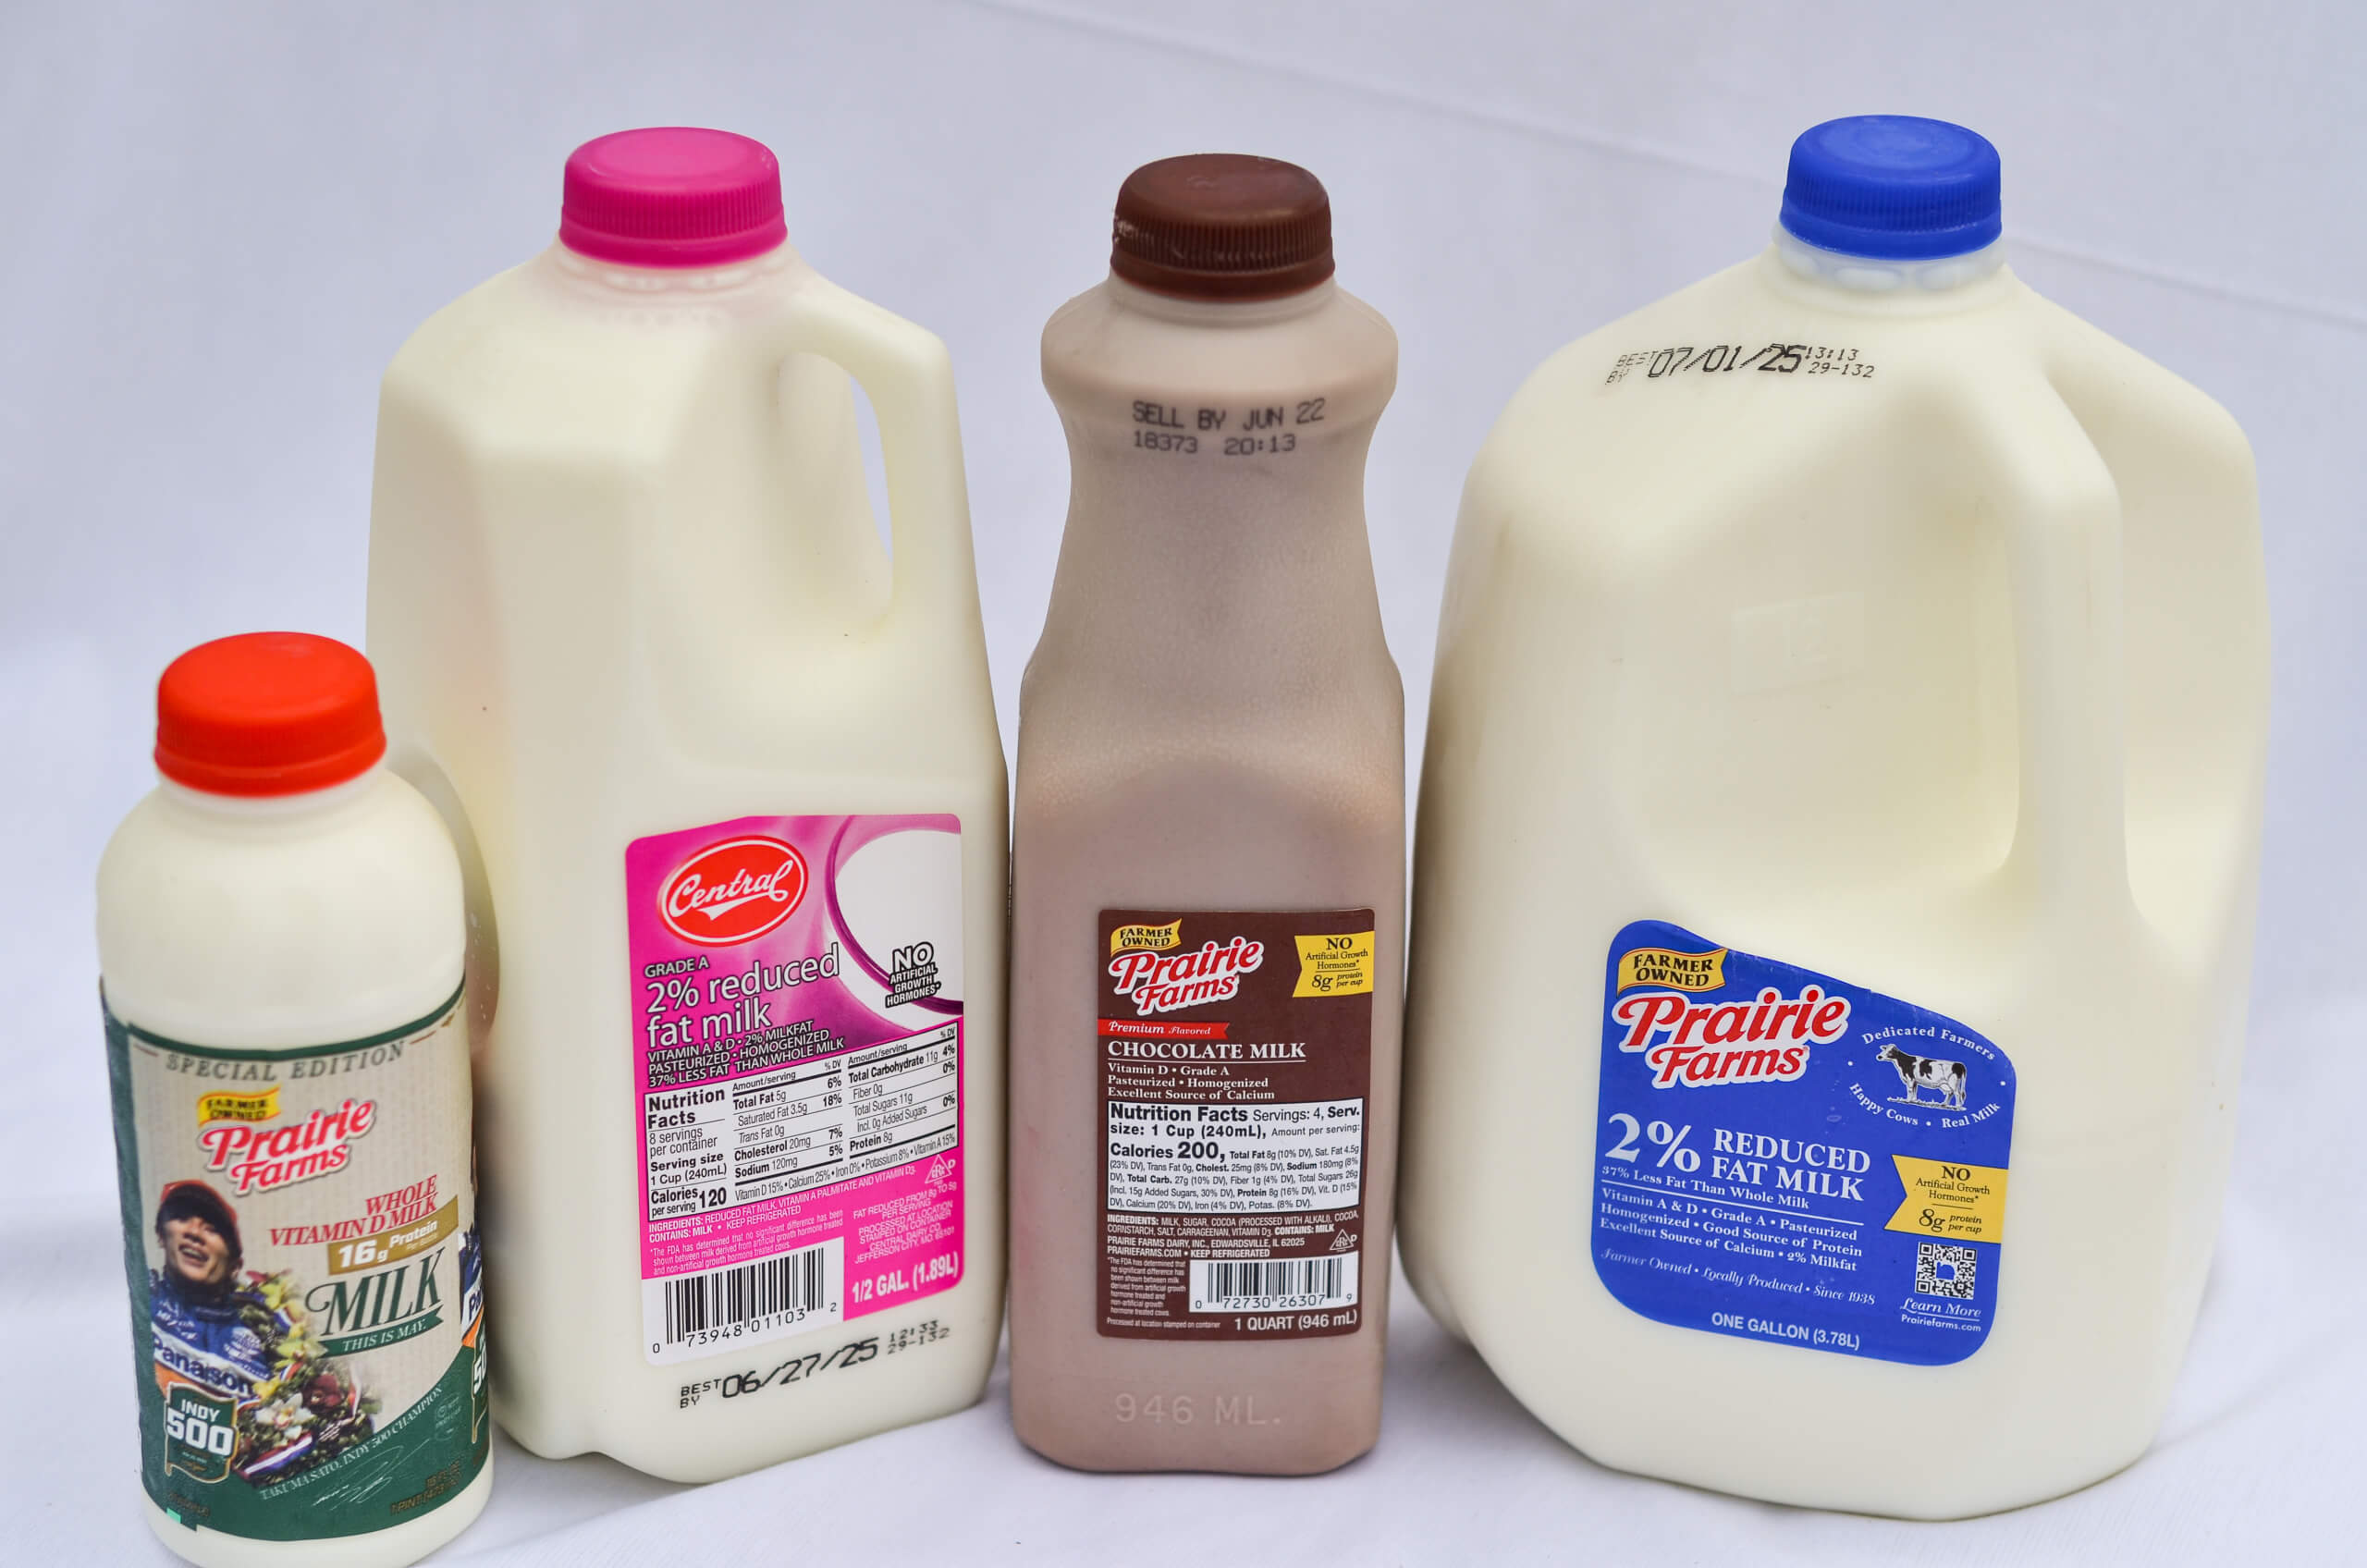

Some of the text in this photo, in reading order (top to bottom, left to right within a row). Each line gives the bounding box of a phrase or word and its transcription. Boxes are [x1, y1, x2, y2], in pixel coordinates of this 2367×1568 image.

[1648, 342, 1808, 379] 07/01/25
[1808, 361, 1875, 379] 29-132
[1132, 397, 1326, 432] SELL BY JUN 22
[1222, 433, 1296, 456] 20:13
[668, 859, 794, 918] Central
[1120, 926, 1173, 939] FARMER
[1122, 937, 1171, 949] OWNED
[1326, 937, 1354, 951] NO
[644, 956, 710, 978] GRADE A
[892, 941, 935, 974] NO
[1110, 937, 1261, 991] Prairie
[1305, 948, 1368, 962] Artificial Growth
[1633, 953, 1715, 973] FARMER
[647, 941, 840, 1014] 2% reduced
[889, 963, 938, 986] ARTIFICIAL
[894, 975, 934, 995] GROWTH
[1311, 974, 1333, 992] 8g
[1336, 979, 1364, 989] per cup
[1337, 972, 1364, 982] protein
[1635, 967, 1711, 988] OWNED
[1134, 975, 1240, 1011] Farms
[647, 996, 772, 1048] fat milk
[1109, 1020, 1212, 1036] Premium Flavored
[1617, 988, 1846, 1048] Prairie
[649, 1028, 830, 1076] PASTEURIZED HOMOGENIZED
[1108, 1040, 1306, 1060] CHOCOLATE MILK
[1860, 1025, 1997, 1061] Dedicated Farmers
[166, 1041, 406, 1083] SPECIAL EDITION
[649, 1036, 845, 1088] 37% LESS FAT THAN WHOLE MILK
[1650, 1045, 1805, 1084] Farms
[1108, 1075, 1269, 1091] Pasteurized Homogenized
[1108, 1087, 1276, 1101] Excellent Source of Calcium
[649, 1089, 726, 1112] Nutrition
[1110, 1102, 1360, 1124] Nutrition Facts Servings: 4, Serv.
[1849, 1082, 1919, 1127] Happy Cows
[648, 1111, 696, 1130] Facts
[1941, 1101, 2002, 1129] Real Milk
[202, 1097, 374, 1167] Prairie
[1110, 1121, 1267, 1140] size: 1 Cup (240mL),
[1604, 1112, 1872, 1175] 2% REDUCED
[1110, 1141, 1225, 1163] Calories 200,
[231, 1144, 350, 1191] Farms
[1711, 1155, 1866, 1203] FAT MILK
[1940, 1165, 1972, 1182] NO
[363, 1174, 438, 1217] WHOLE
[651, 1187, 728, 1209] Calories 120
[1601, 1165, 1811, 1210] 37% Less Fat Than Whole Milk
[1915, 1177, 1991, 1195] Artificial Growth
[270, 1192, 439, 1246] VITAMIN D MILK
[1600, 1203, 1864, 1258] Homogenized Good Source of Protein
[1918, 1207, 1947, 1233] 8g
[1948, 1214, 1983, 1225] protein
[389, 1219, 438, 1248] Protein
[1600, 1218, 1858, 1274] Excellent Source of Calcium 2% Milkfat
[852, 1251, 960, 1304] 1/2 GAL. (1.89L)
[1600, 1248, 1877, 1306] Farmer Owned Locally Produced Since 1938
[305, 1246, 446, 1337] MILK
[1222, 1294, 1327, 1309] 72730 26307
[1234, 1317, 1242, 1331] 1
[1246, 1316, 1295, 1331] QUART
[1297, 1315, 1330, 1331] (946
[1332, 1309, 1359, 1328] mL)
[1899, 1296, 1983, 1318] Learn More
[687, 1308, 806, 1348] 73948 01103
[1711, 1311, 1861, 1351] ONE GALLON (3.78L)
[1900, 1313, 1983, 1334] Prairiefarms.com
[342, 1334, 378, 1352] THIS
[381, 1329, 395, 1344] IS
[681, 1378, 722, 1397] BEST
[721, 1337, 880, 1399] 06/27/25
[181, 1399, 222, 1424] INDY
[680, 1395, 701, 1409] BY
[1115, 1392, 1194, 1426] 946
[166, 1407, 235, 1457] 500
